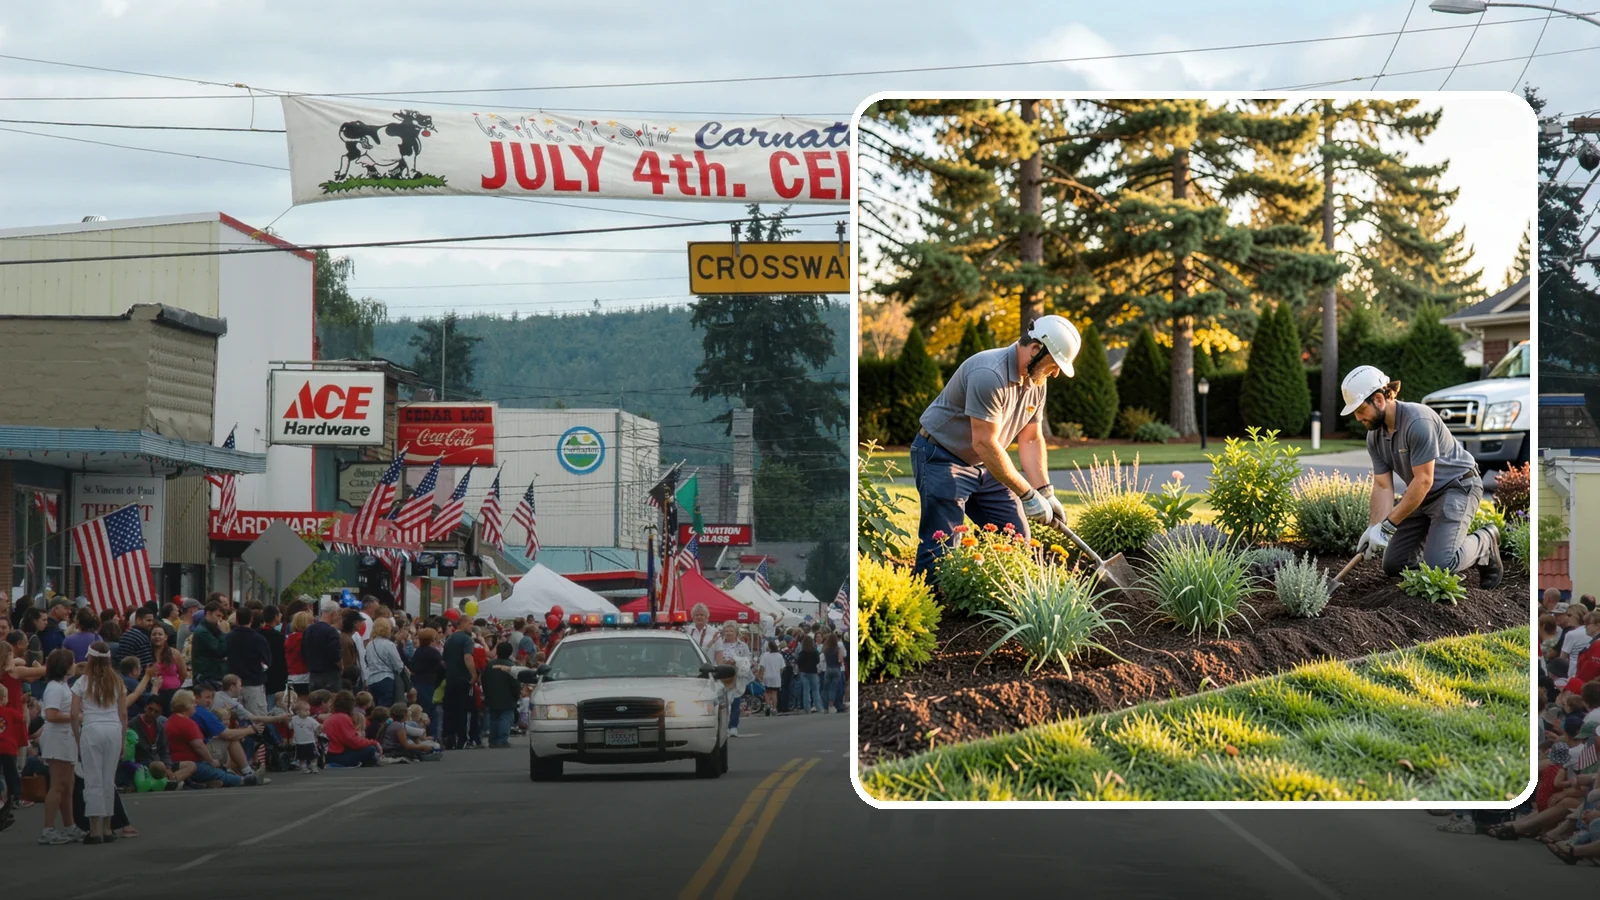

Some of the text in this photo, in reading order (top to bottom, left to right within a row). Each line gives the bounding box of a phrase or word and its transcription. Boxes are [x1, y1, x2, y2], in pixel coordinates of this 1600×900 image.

[481, 141, 605, 192] JULY
[632, 150, 746, 198] 4th.
[696, 254, 850, 280] CROSSWA
[282, 380, 373, 420] ACE
[406, 409, 485, 421] CEDAR LOG
[283, 421, 371, 437] Hardware
[416, 428, 477, 447] Coca-Cola
[353, 467, 385, 481] Simpl
[95, 485, 124, 495] Vincent
[126, 486, 135, 495] de
[137, 486, 155, 495] Paul
[688, 526, 741, 535] CRNATION
